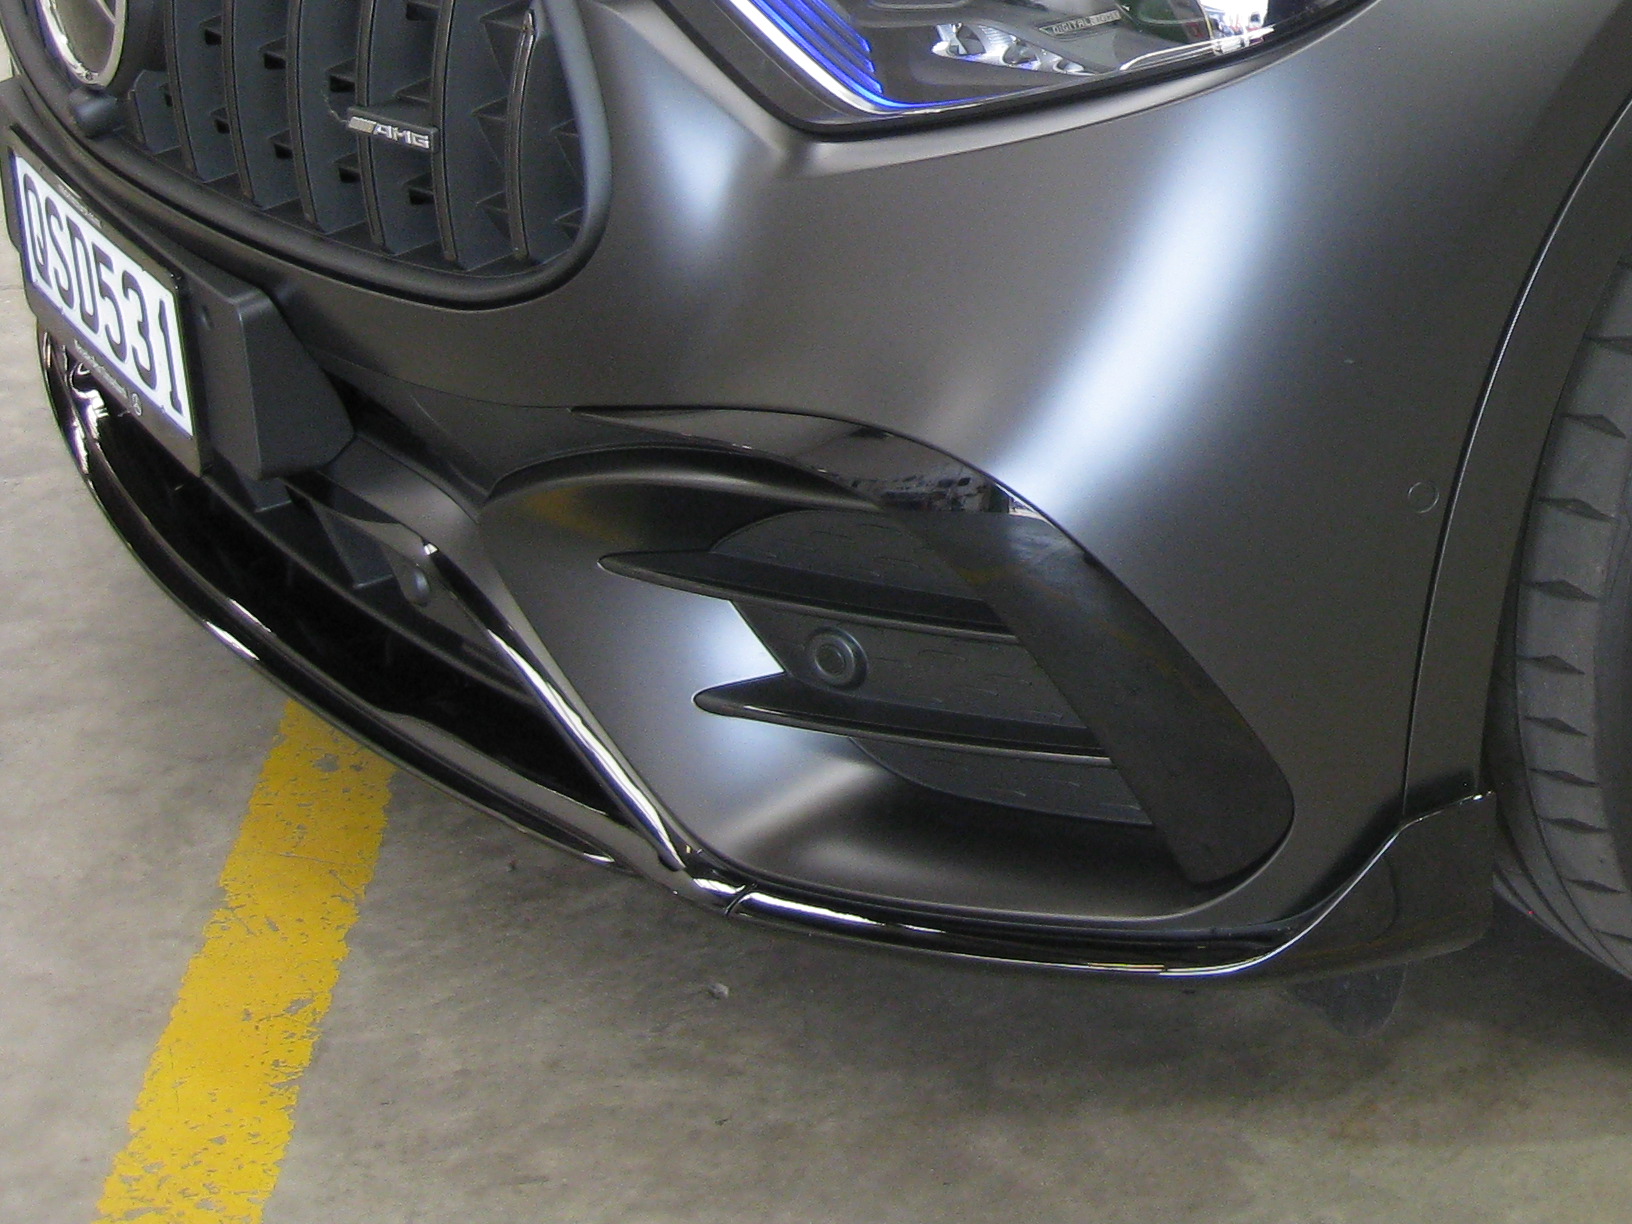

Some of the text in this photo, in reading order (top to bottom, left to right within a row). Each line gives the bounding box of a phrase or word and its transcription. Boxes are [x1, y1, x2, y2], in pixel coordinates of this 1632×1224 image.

[1052, 17, 1091, 33] DIGITAL
[373, 122, 430, 149] AMG
[23, 173, 184, 416] QSD531
